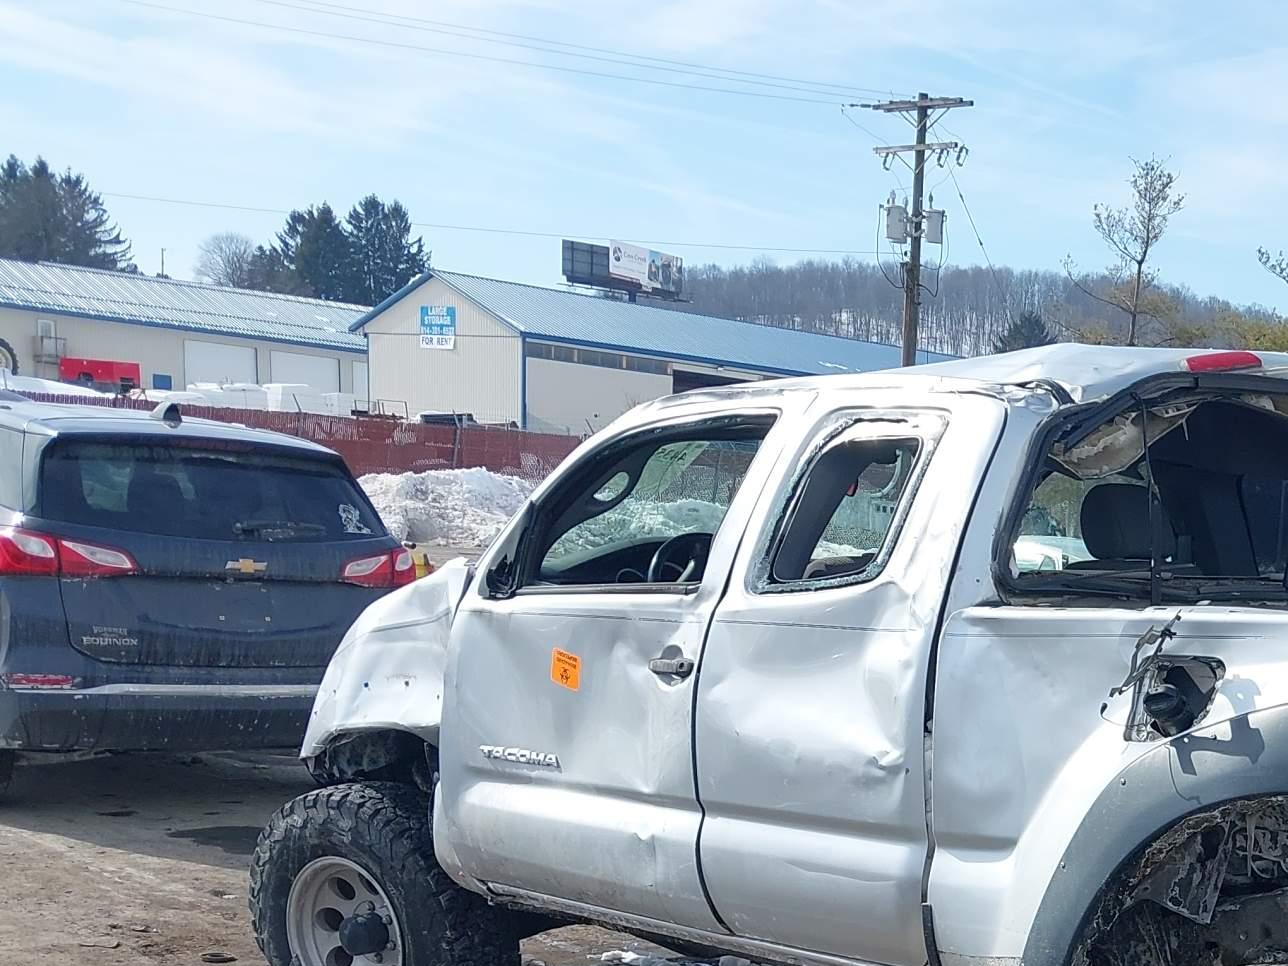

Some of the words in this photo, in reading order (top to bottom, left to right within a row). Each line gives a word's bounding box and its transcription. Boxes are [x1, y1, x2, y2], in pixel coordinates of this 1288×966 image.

[427, 306, 448, 316] LARGE
[424, 316, 452, 325] STORAGE
[421, 336, 434, 345] FOR
[436, 337, 453, 346] RENT
[82, 636, 138, 646] EQUINOX
[479, 744, 562, 769] TACOMA
